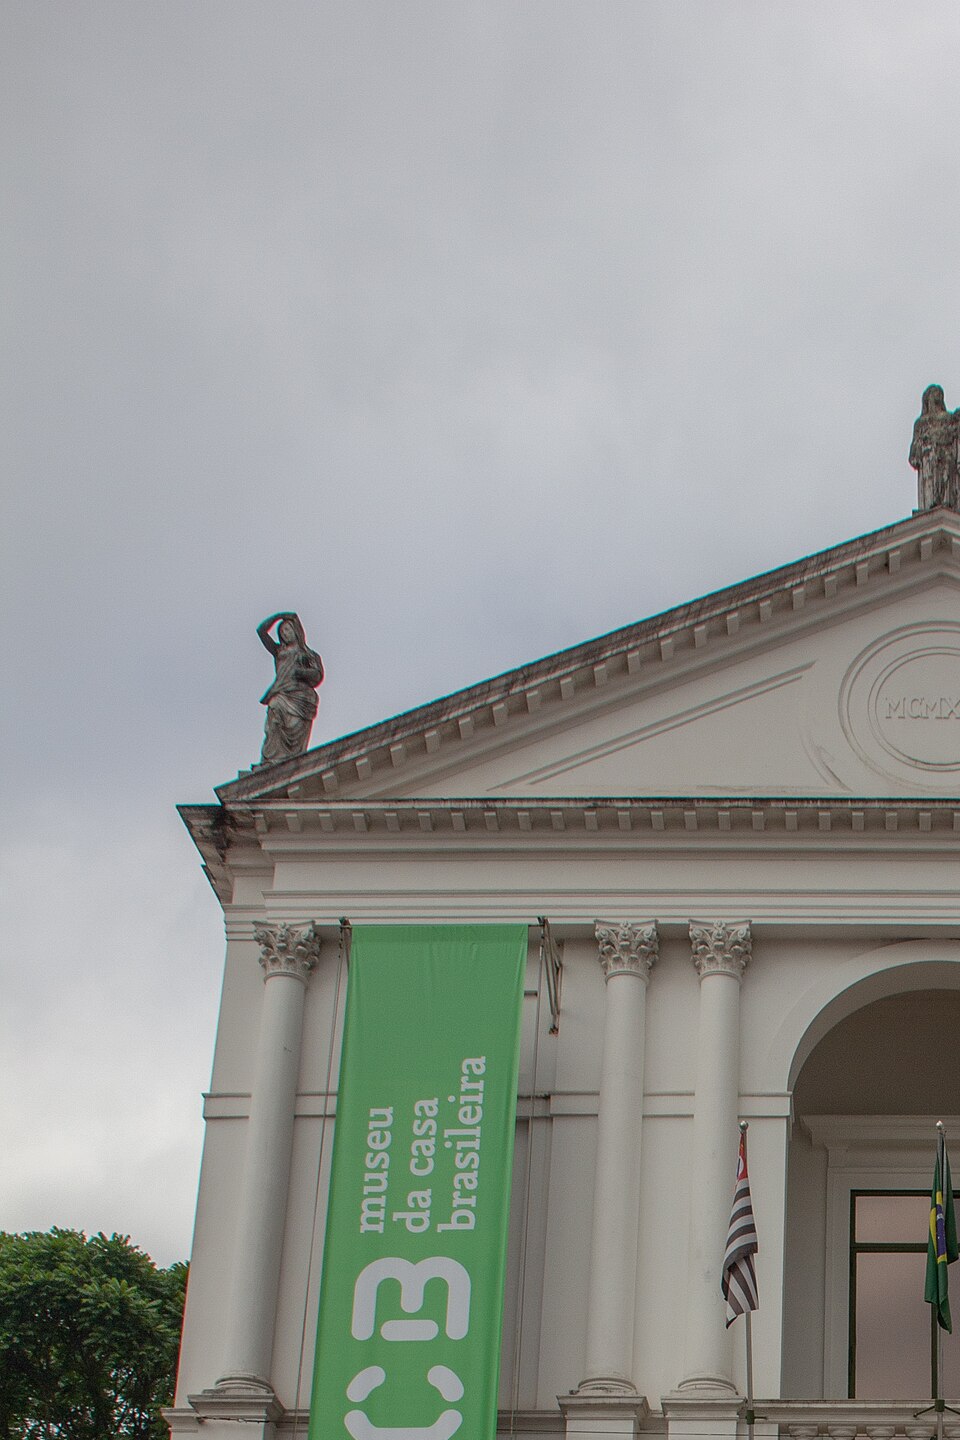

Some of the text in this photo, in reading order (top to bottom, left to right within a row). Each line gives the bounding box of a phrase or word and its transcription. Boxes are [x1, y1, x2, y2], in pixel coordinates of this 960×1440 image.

[359, 1106, 394, 1234] museu
[392, 1097, 439, 1234] da casa
[436, 1055, 486, 1233] brasileira
